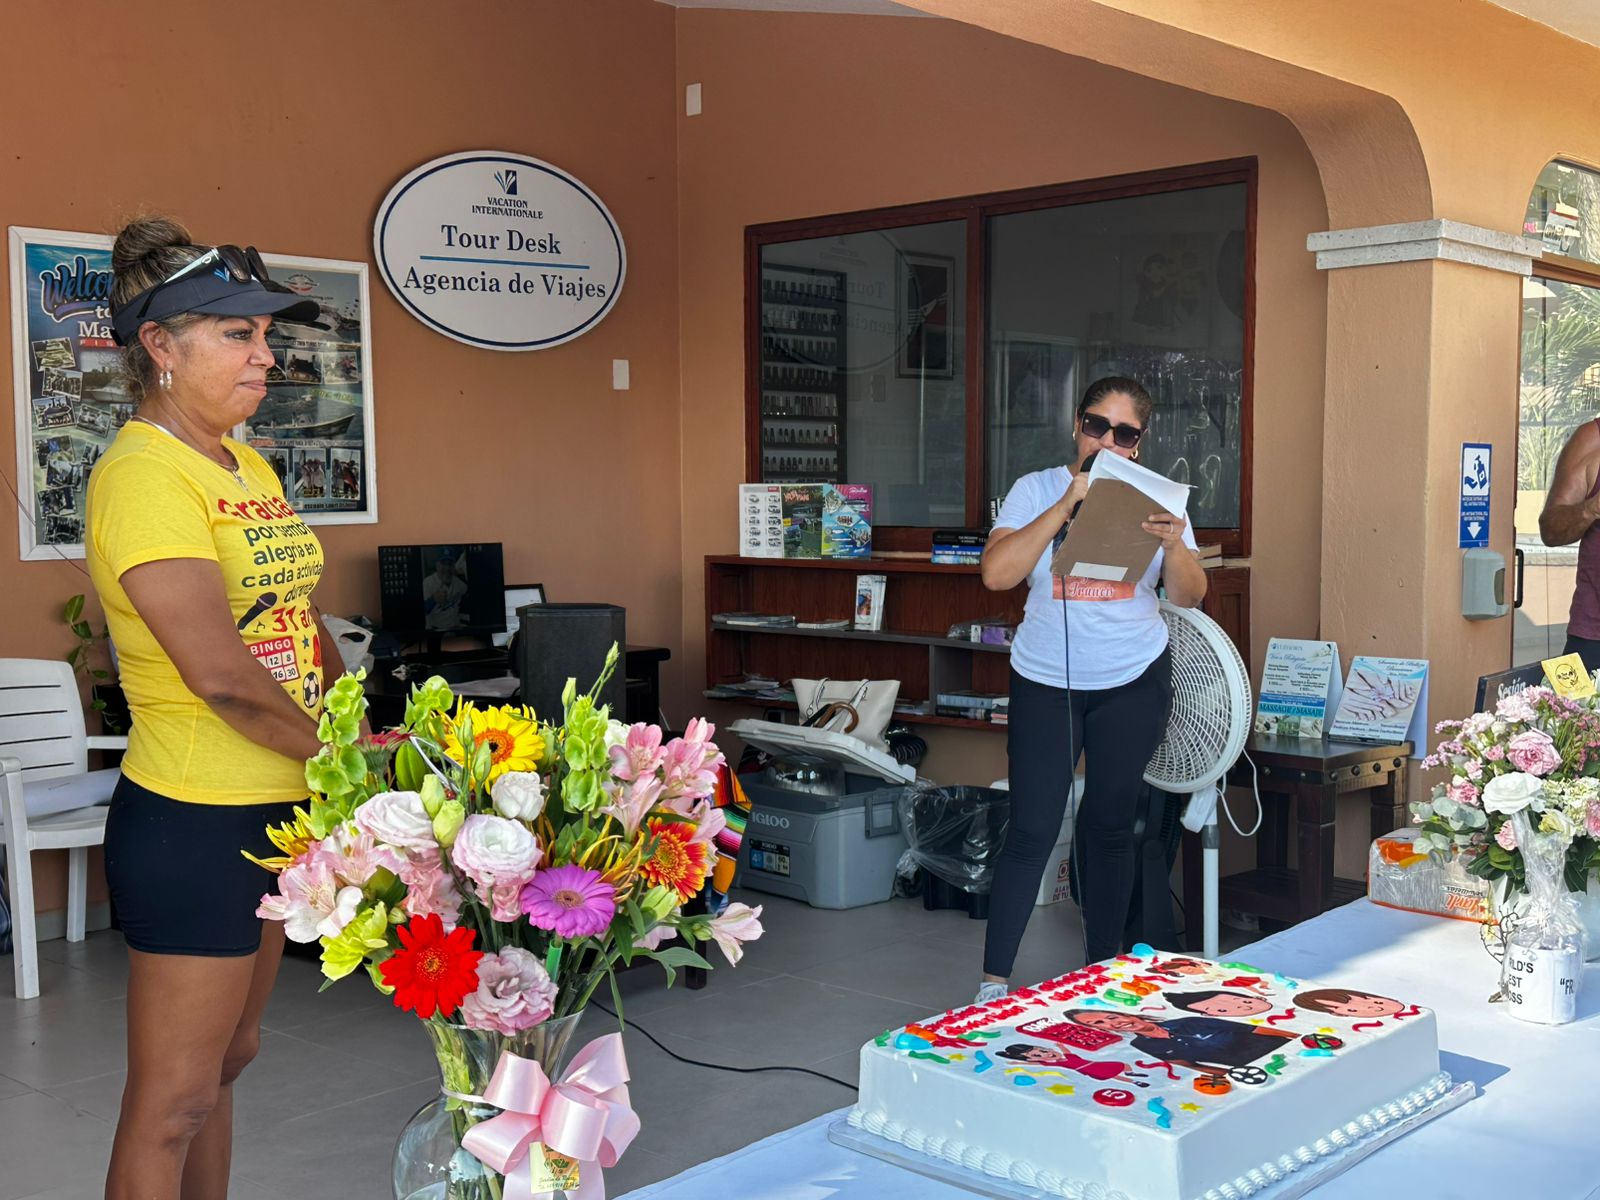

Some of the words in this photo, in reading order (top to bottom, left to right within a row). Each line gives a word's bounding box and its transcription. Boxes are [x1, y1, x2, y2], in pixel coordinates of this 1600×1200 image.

[487, 197, 529, 208] VACATION
[472, 205, 544, 219] INTERNATIONALE
[441, 224, 500, 250] Tour
[506, 229, 561, 255] Desk
[40, 254, 113, 314] Welco
[403, 266, 501, 295] Agencia
[508, 272, 535, 294] de
[540, 273, 606, 301] Viajes
[78, 321, 115, 338] Ma
[218, 493, 295, 521] Gracia
[243, 524, 279, 547] por
[275, 520, 312, 538] sembr
[305, 542, 318, 555] en
[241, 567, 294, 588] cada
[297, 560, 323, 580] activida
[250, 639, 292, 656] BINGO
[269, 655, 280, 666] 12
[286, 653, 292, 662] 8
[287, 668, 296, 678] 30
[752, 811, 790, 829] IGLOO
[1508, 974, 1523, 988] EST
[1101, 1089, 1127, 1100] 5
